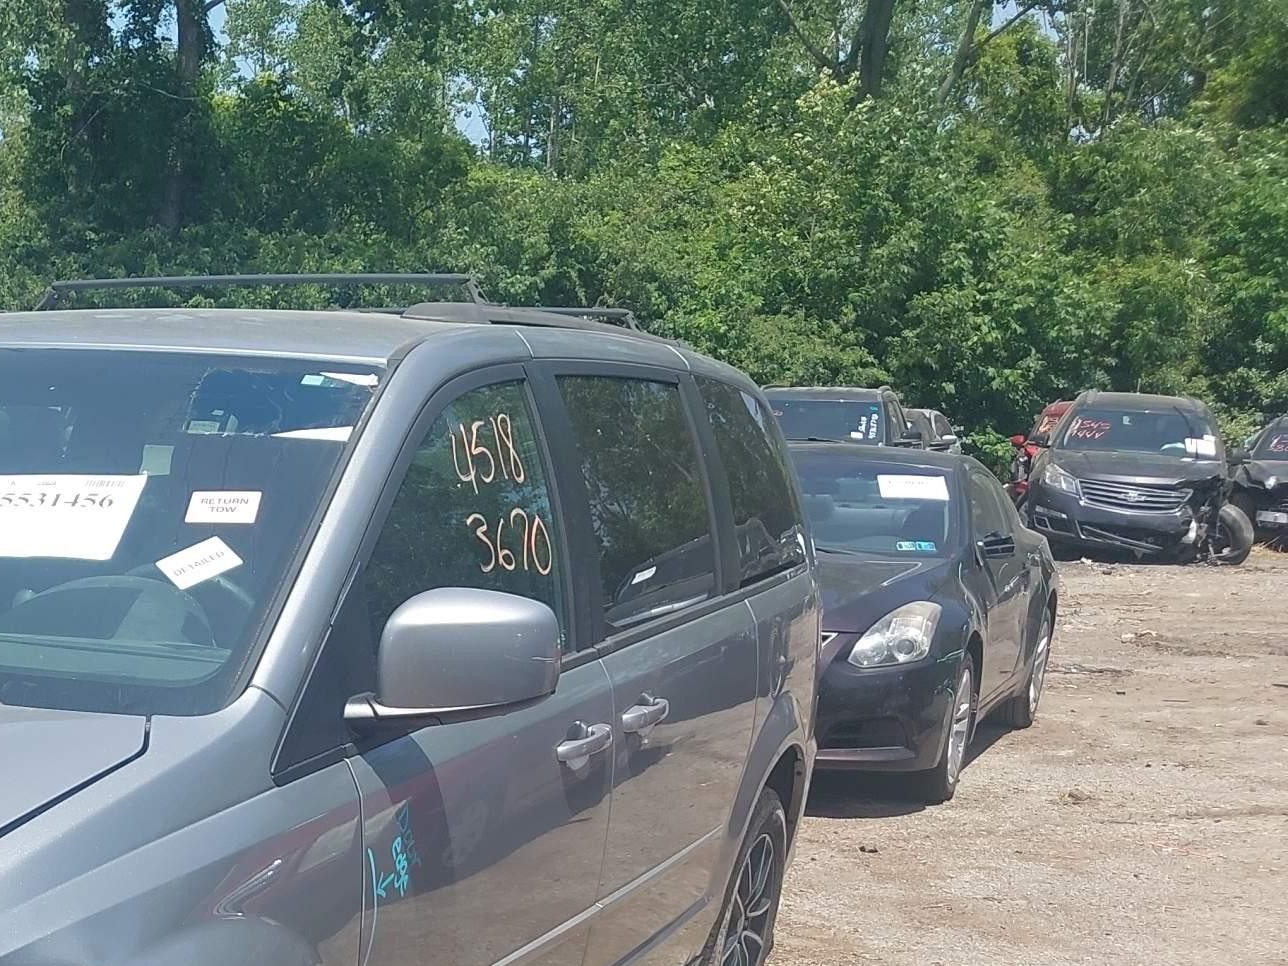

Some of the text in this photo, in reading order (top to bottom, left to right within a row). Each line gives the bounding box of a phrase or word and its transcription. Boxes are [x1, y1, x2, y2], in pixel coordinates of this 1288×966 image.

[447, 412, 525, 495] 4518
[173, 551, 225, 577] DETAILED
[466, 507, 552, 575] 3670
